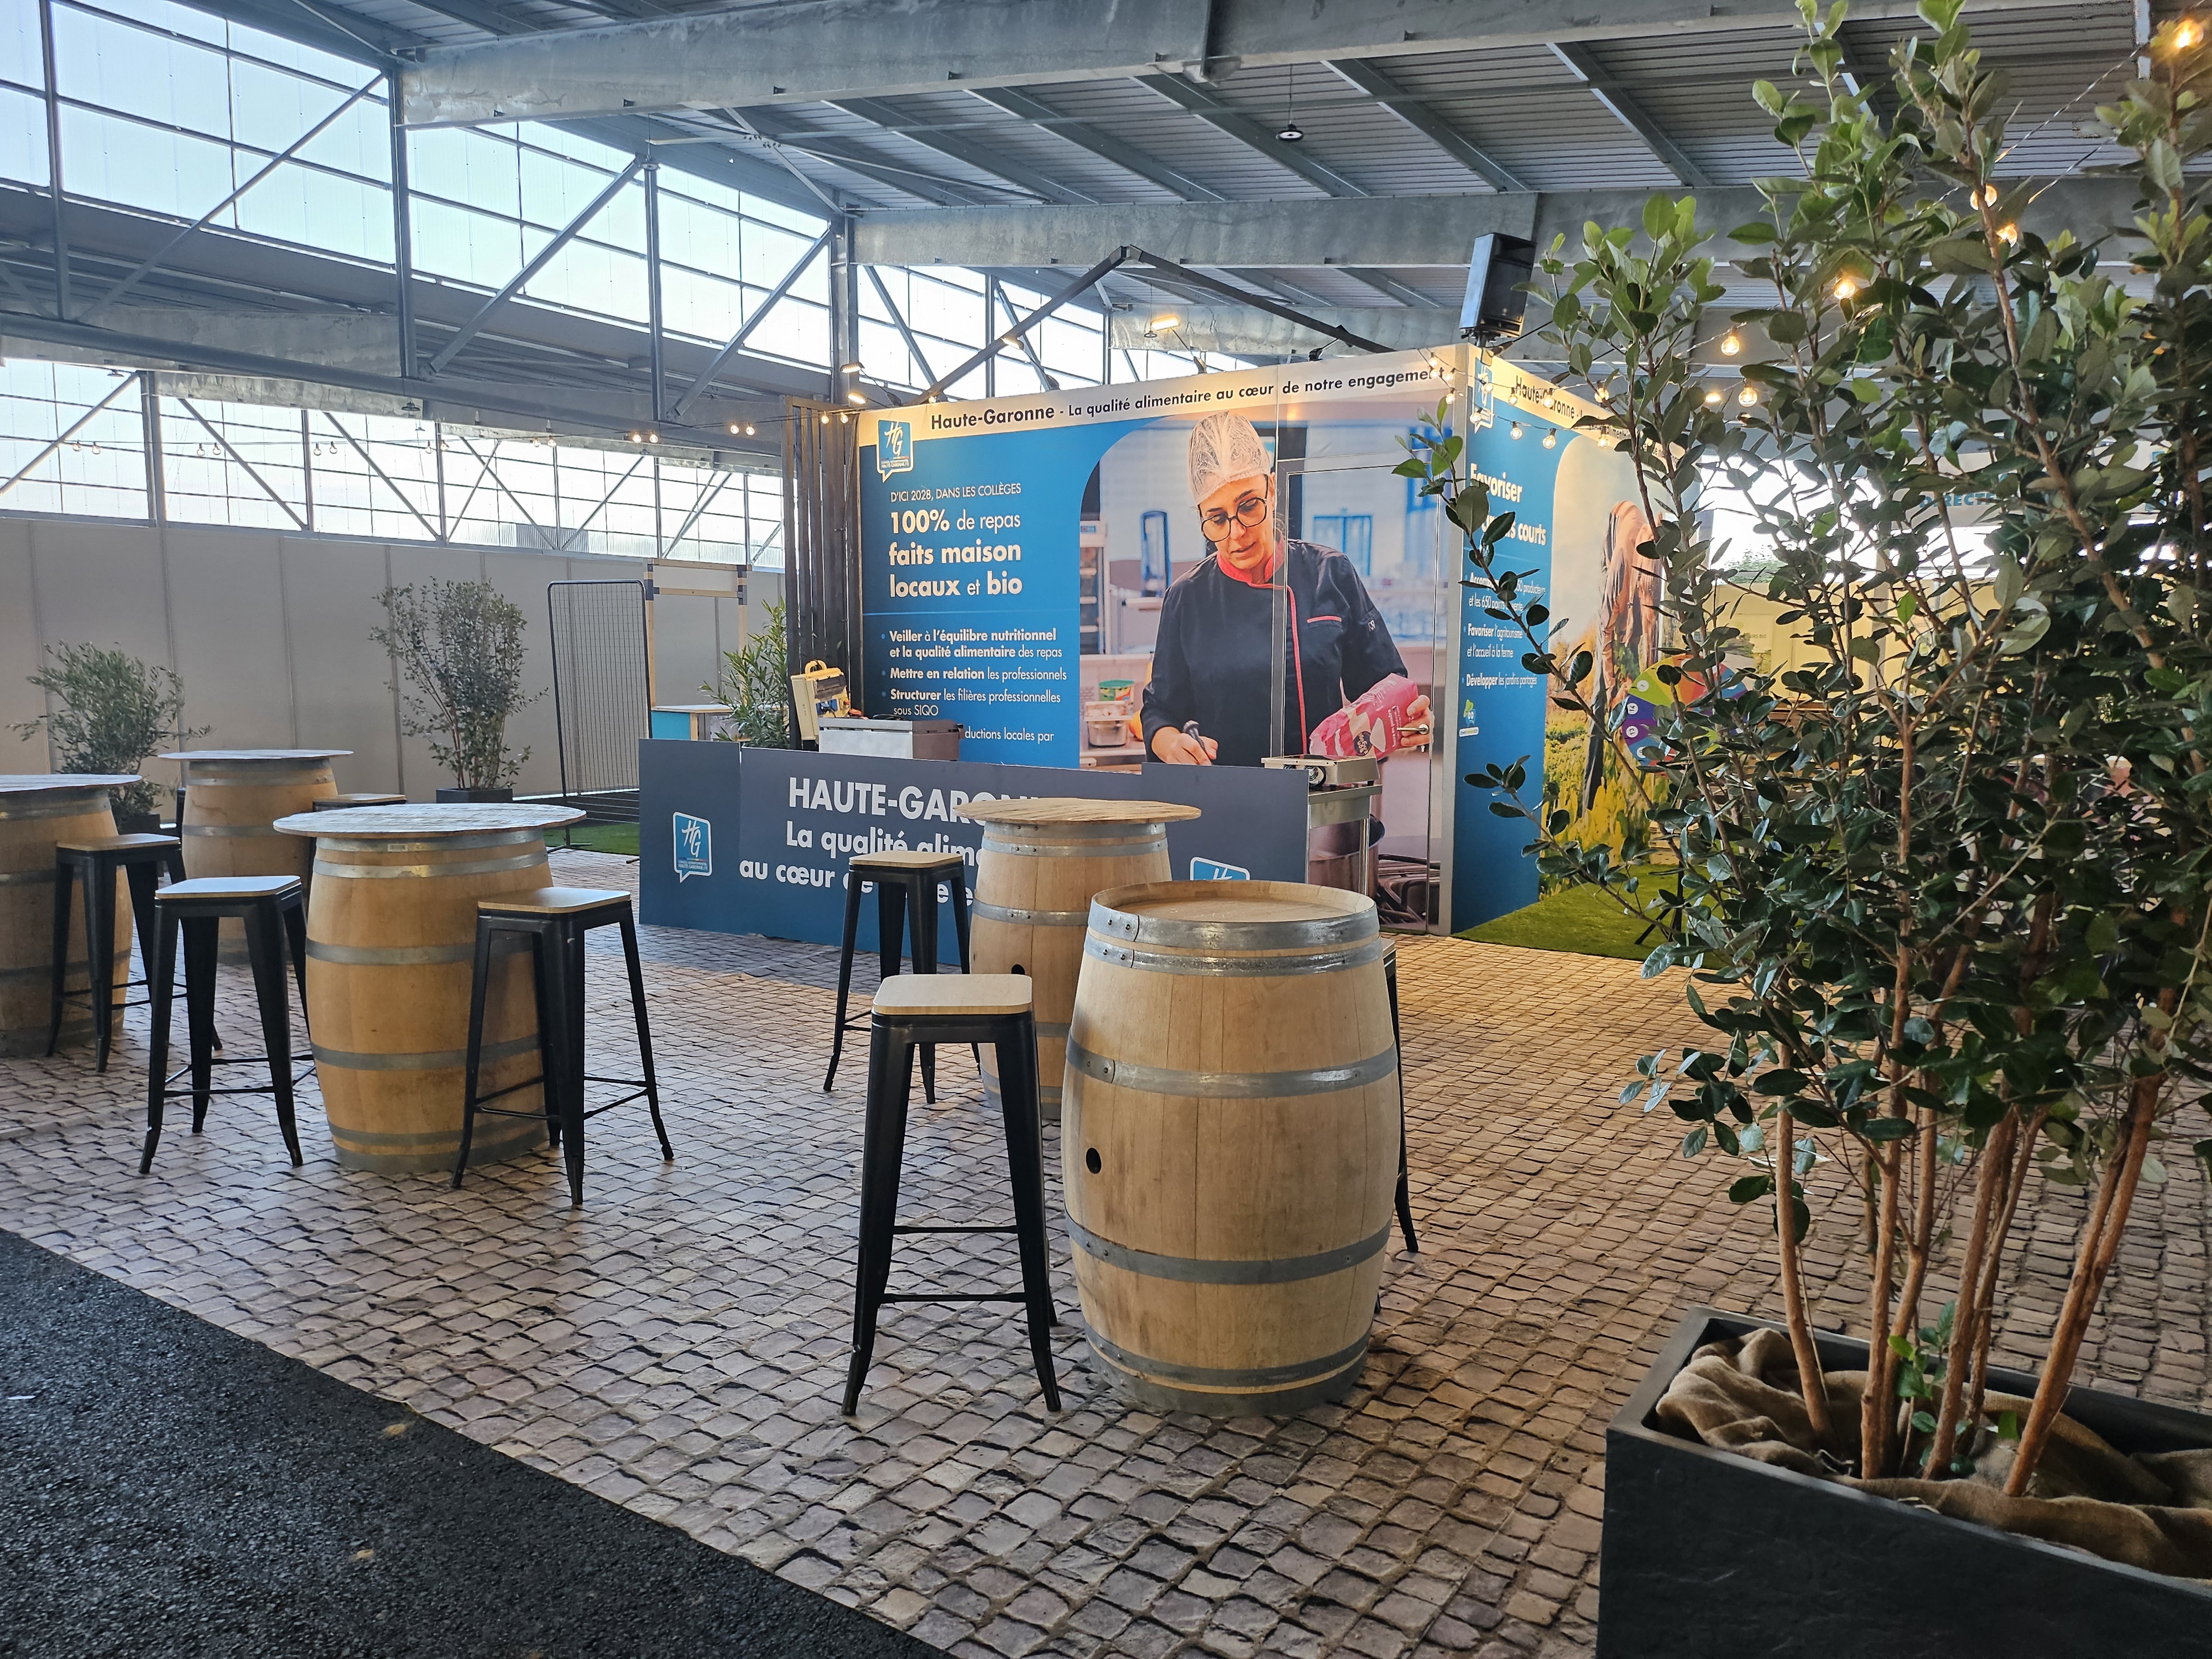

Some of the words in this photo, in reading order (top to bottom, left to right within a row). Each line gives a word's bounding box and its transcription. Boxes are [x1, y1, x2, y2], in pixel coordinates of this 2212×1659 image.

[931, 406, 1055, 430] Haute-Garonne
[1068, 405, 1082, 416] La
[1087, 398, 1130, 418] qualité
[1135, 390, 1212, 409] alimentaire
[1217, 389, 1234, 400] au
[1239, 385, 1274, 398] cœur
[1282, 380, 1300, 394] de
[1305, 378, 1343, 392] notre
[1516, 375, 1575, 419] Haute-ronne
[884, 421, 904, 457] HG
[890, 491, 909, 503] D'ICI
[911, 489, 934, 502] 2028,
[936, 487, 960, 498] DANS
[962, 486, 975, 498] LES
[978, 481, 1021, 497] COLLÈGES
[890, 508, 950, 534] 100%
[956, 508, 975, 530] de
[979, 514, 1021, 534] repas
[1517, 523, 1547, 546] courts
[889, 541, 935, 566] faits
[941, 538, 1021, 564] maison
[890, 573, 961, 597] locaux
[967, 579, 981, 596] et
[987, 570, 1022, 595] bio
[1469, 597, 1474, 606] et
[1481, 596, 1491, 608] 650
[889, 629, 922, 642] Veiller
[925, 630, 931, 641] à
[933, 628, 988, 645] l'équilibre
[991, 627, 1056, 641] nutritionnel
[1468, 623, 1494, 637] Favoriser
[889, 647, 900, 658] et
[902, 645, 912, 658] la
[915, 645, 951, 661] qualité
[953, 644, 1016, 658] alimentaire
[1018, 644, 1034, 658] des
[1036, 648, 1062, 661] repas
[1467, 646, 1472, 657] et
[1473, 643, 1491, 658] l'accueil
[1492, 646, 1495, 658] à
[1496, 644, 1500, 658] la
[1501, 644, 1514, 658] ferme
[890, 667, 924, 679] Mettre
[926, 670, 940, 679] en
[943, 666, 985, 680] relation
[988, 666, 1000, 680] les
[1002, 666, 1067, 683] professionnels
[1466, 672, 1498, 690] Développer
[1505, 672, 1520, 688] jardins
[890, 688, 942, 701] Structurer
[943, 687, 956, 701] les
[958, 687, 987, 702] filières
[989, 688, 1061, 705] professionnelles
[893, 707, 912, 716] sous
[914, 704, 939, 717] SIQO
[965, 726, 1001, 740] ductions
[1004, 726, 1035, 742] locales
[1037, 732, 1055, 745] par
[789, 777, 1040, 826] HAUTE-GAR
[681, 819, 701, 858] HG
[786, 820, 812, 848] La
[821, 826, 908, 859] qualité
[739, 860, 768, 880] au
[775, 864, 835, 888] cœur
